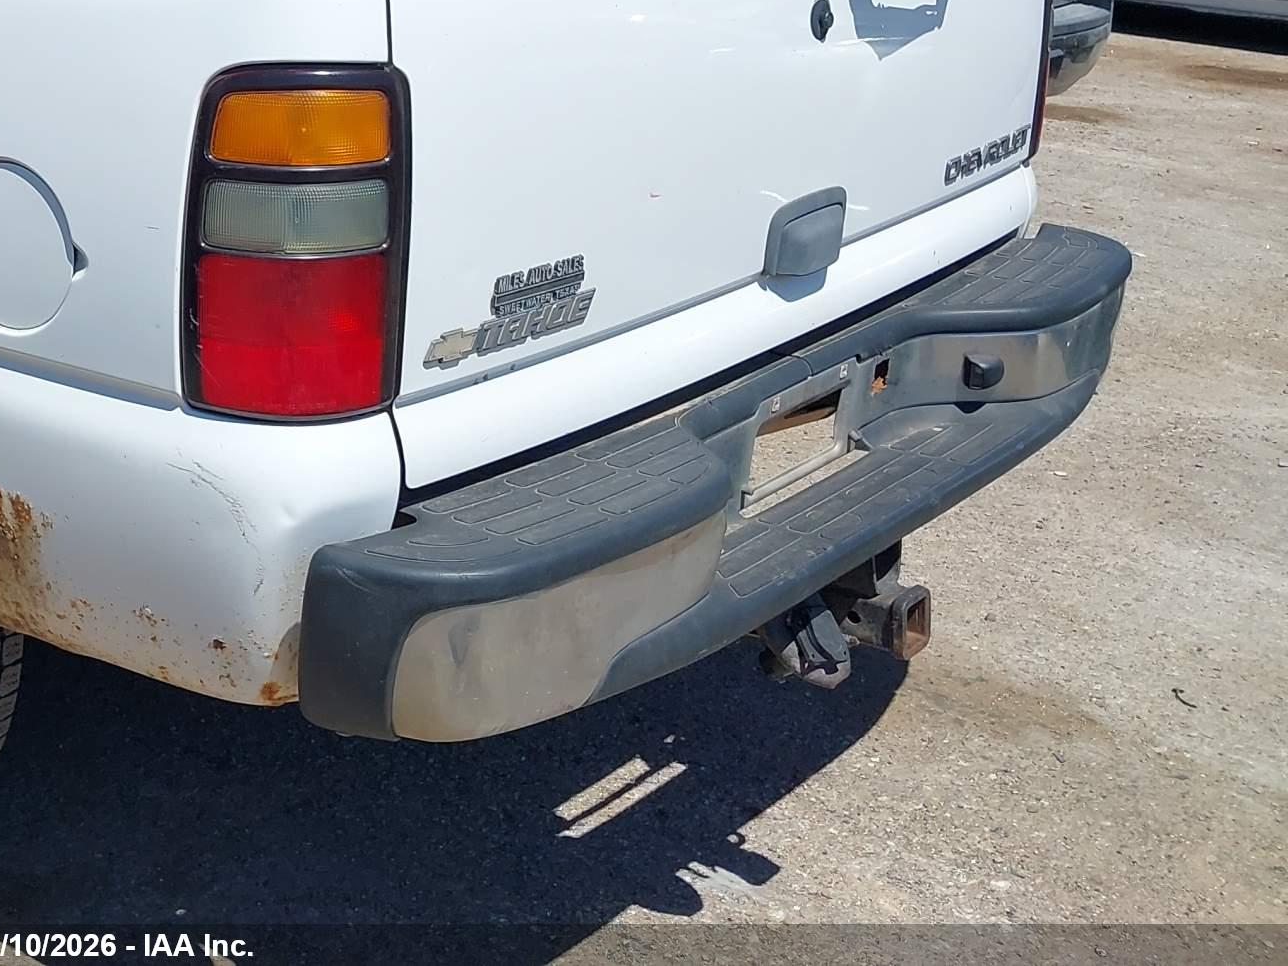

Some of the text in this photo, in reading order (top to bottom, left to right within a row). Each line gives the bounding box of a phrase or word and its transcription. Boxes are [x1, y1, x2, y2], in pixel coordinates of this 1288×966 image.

[944, 123, 1031, 186] CHEVROLET
[497, 255, 584, 294] MILES AUTO SALES
[556, 284, 580, 300] TEXAS
[478, 288, 596, 356] TAHOE
